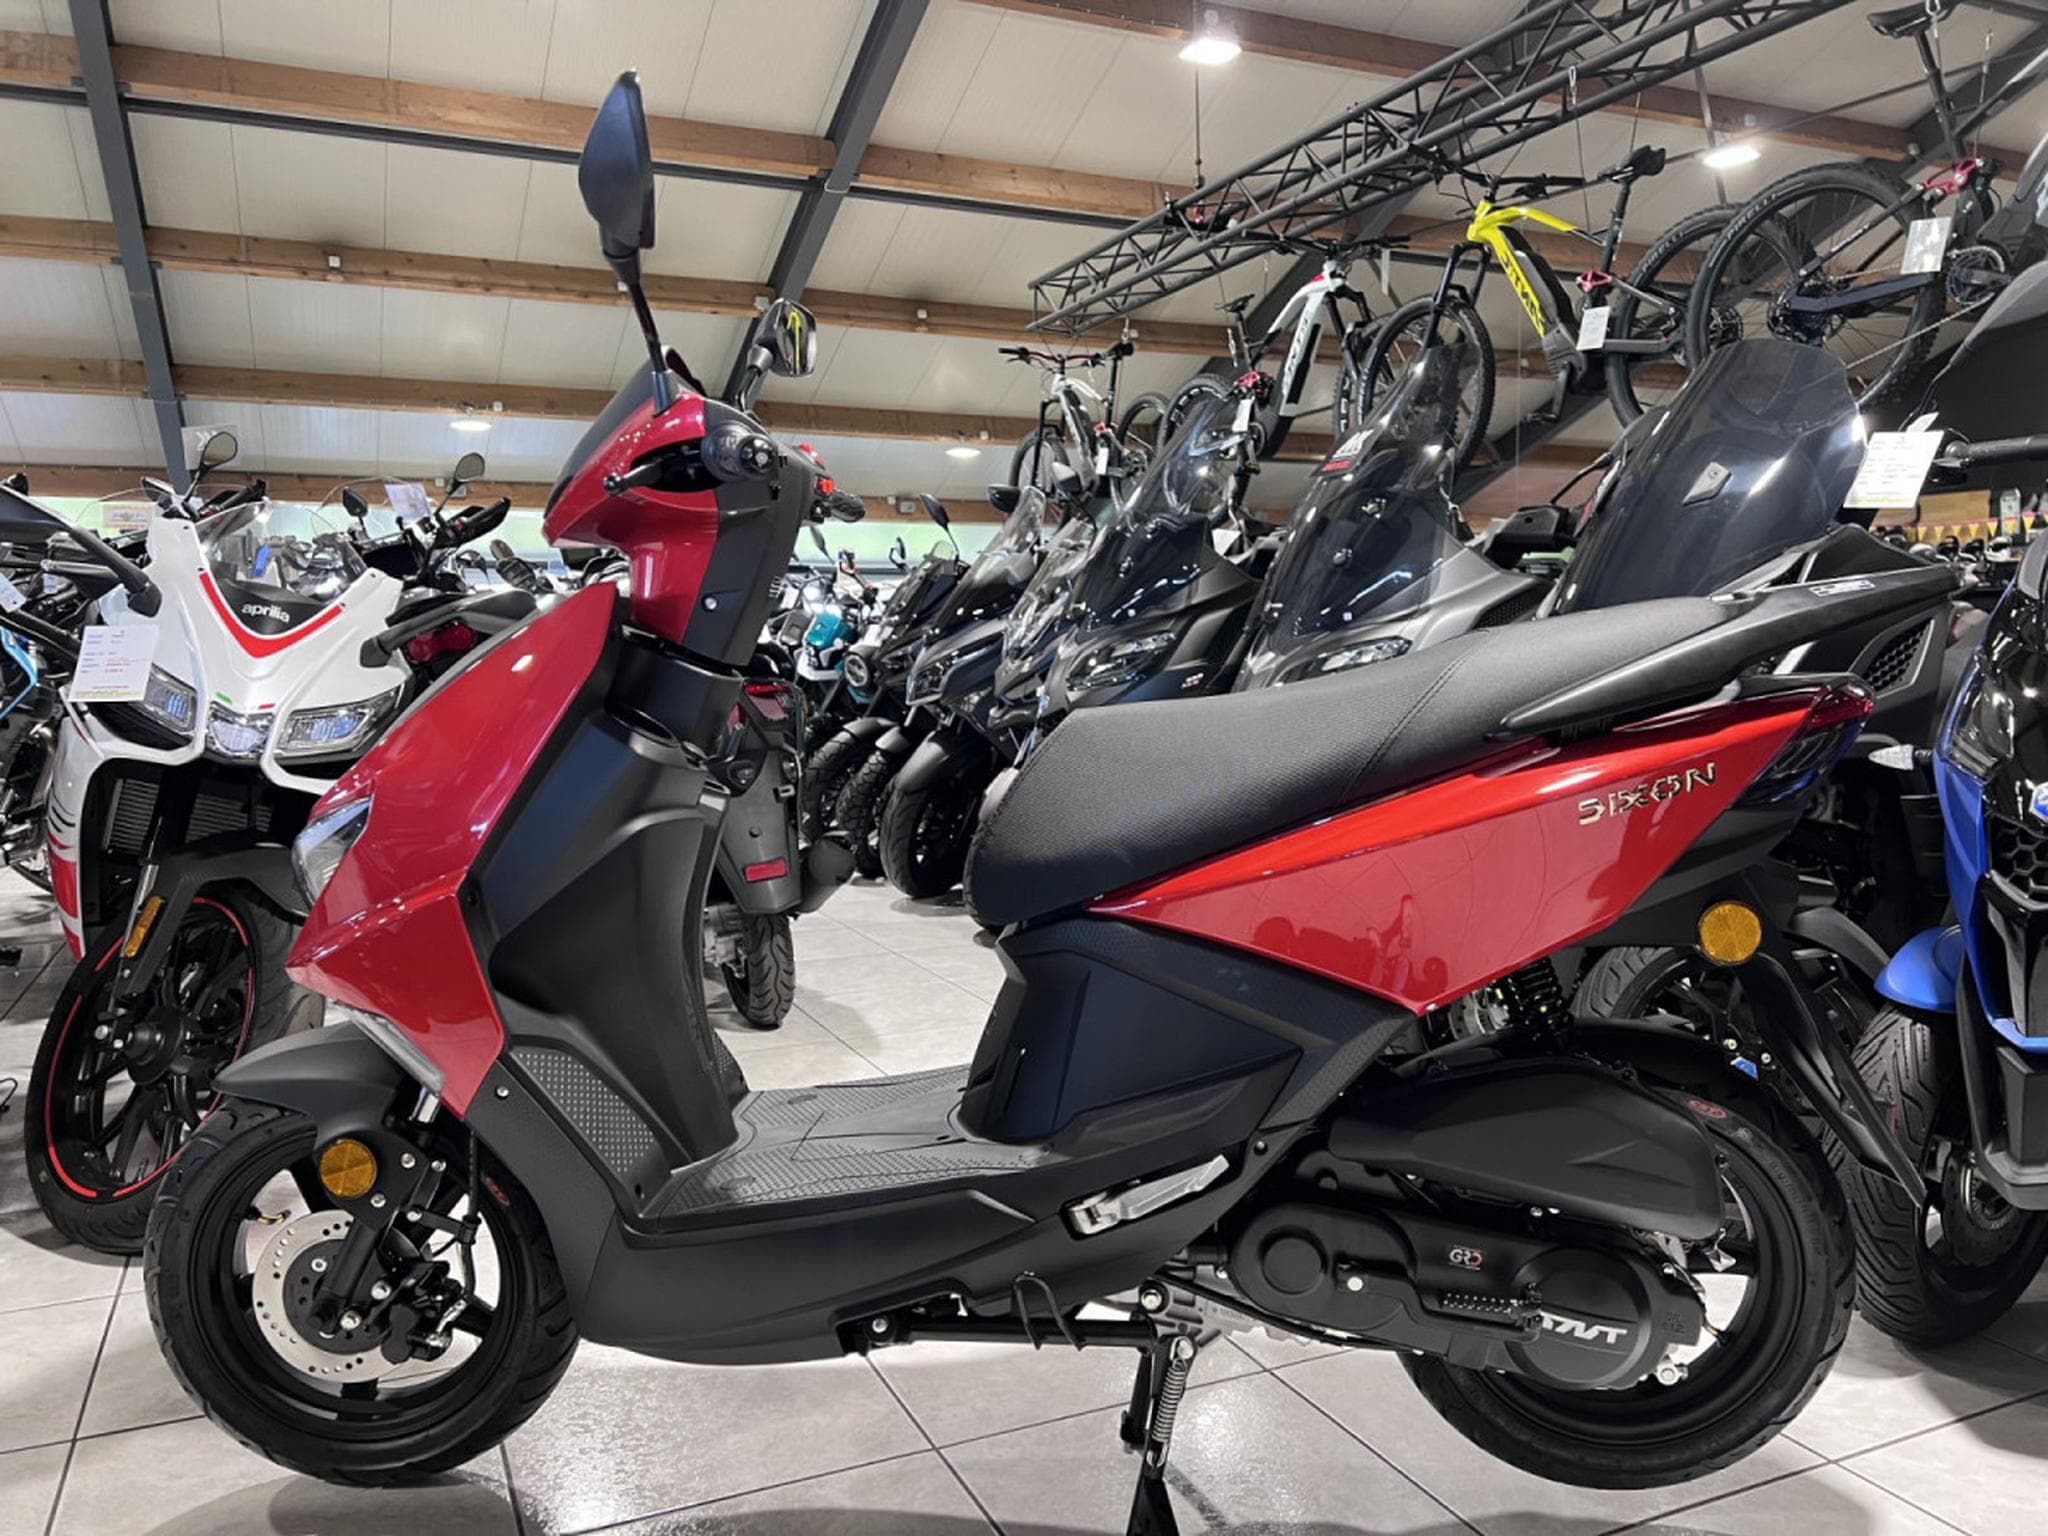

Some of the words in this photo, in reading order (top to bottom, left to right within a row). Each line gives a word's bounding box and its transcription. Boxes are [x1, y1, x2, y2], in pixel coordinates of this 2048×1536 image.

[1726, 193, 1778, 242] PIRELLI
[241, 603, 290, 624] aprilia
[1578, 762, 1716, 825] SIXON
